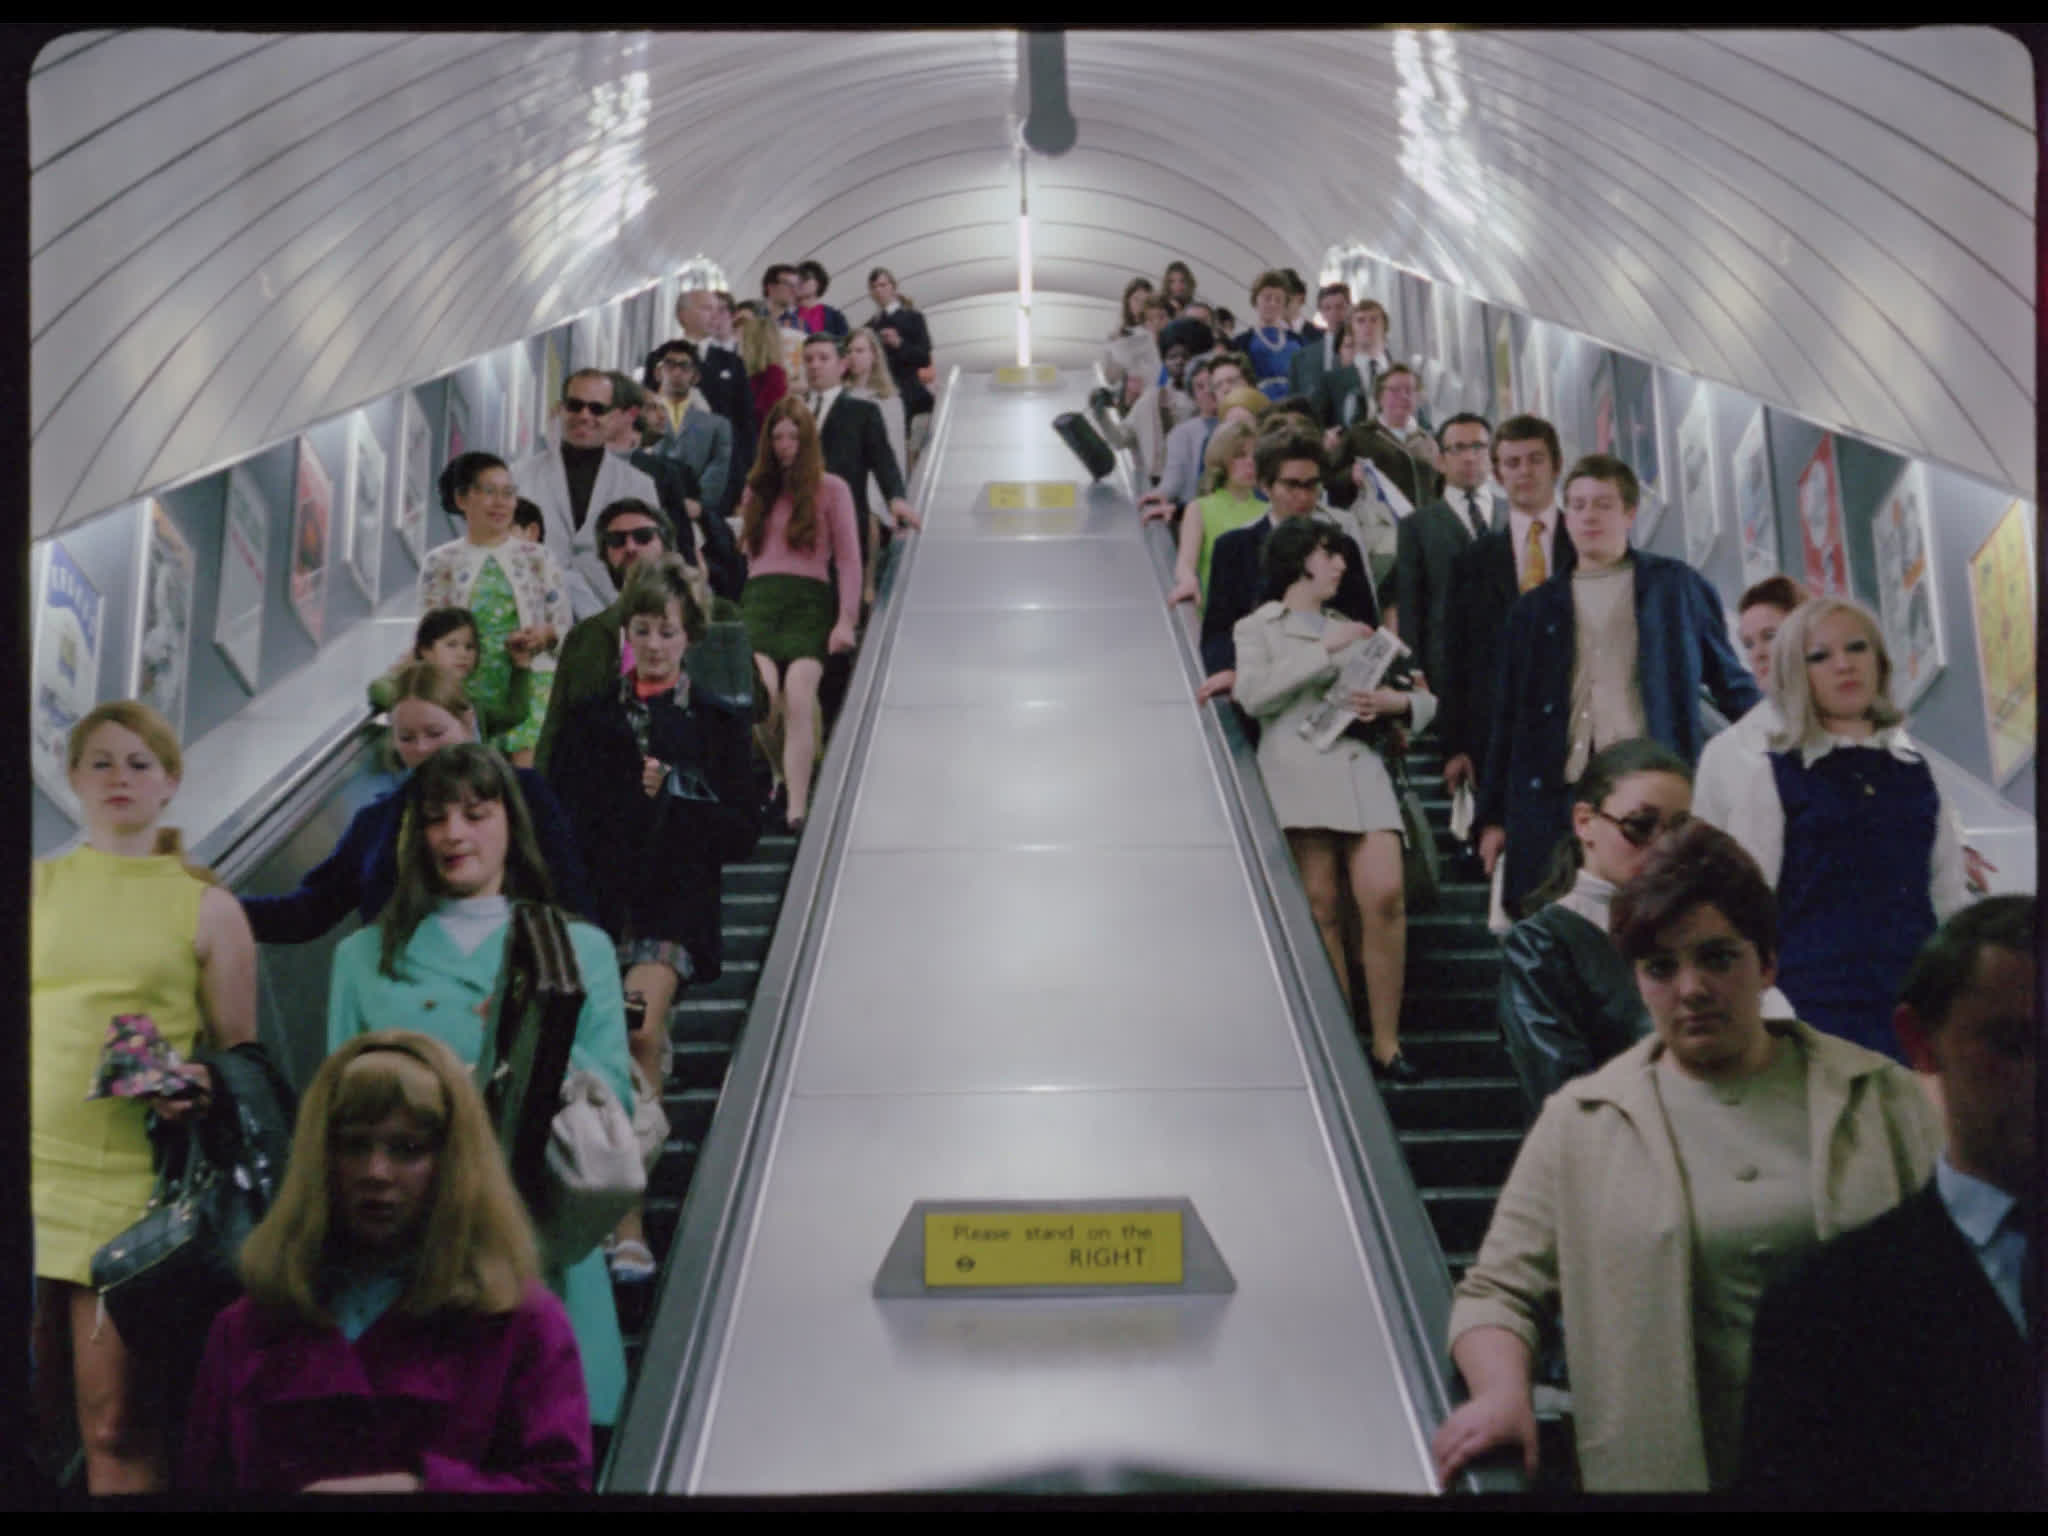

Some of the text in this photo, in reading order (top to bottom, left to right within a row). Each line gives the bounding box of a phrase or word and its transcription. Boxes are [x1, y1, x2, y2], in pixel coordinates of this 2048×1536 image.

[952, 1223, 1152, 1241] Please stand on the
[1069, 1247, 1147, 1268] RIGHT
